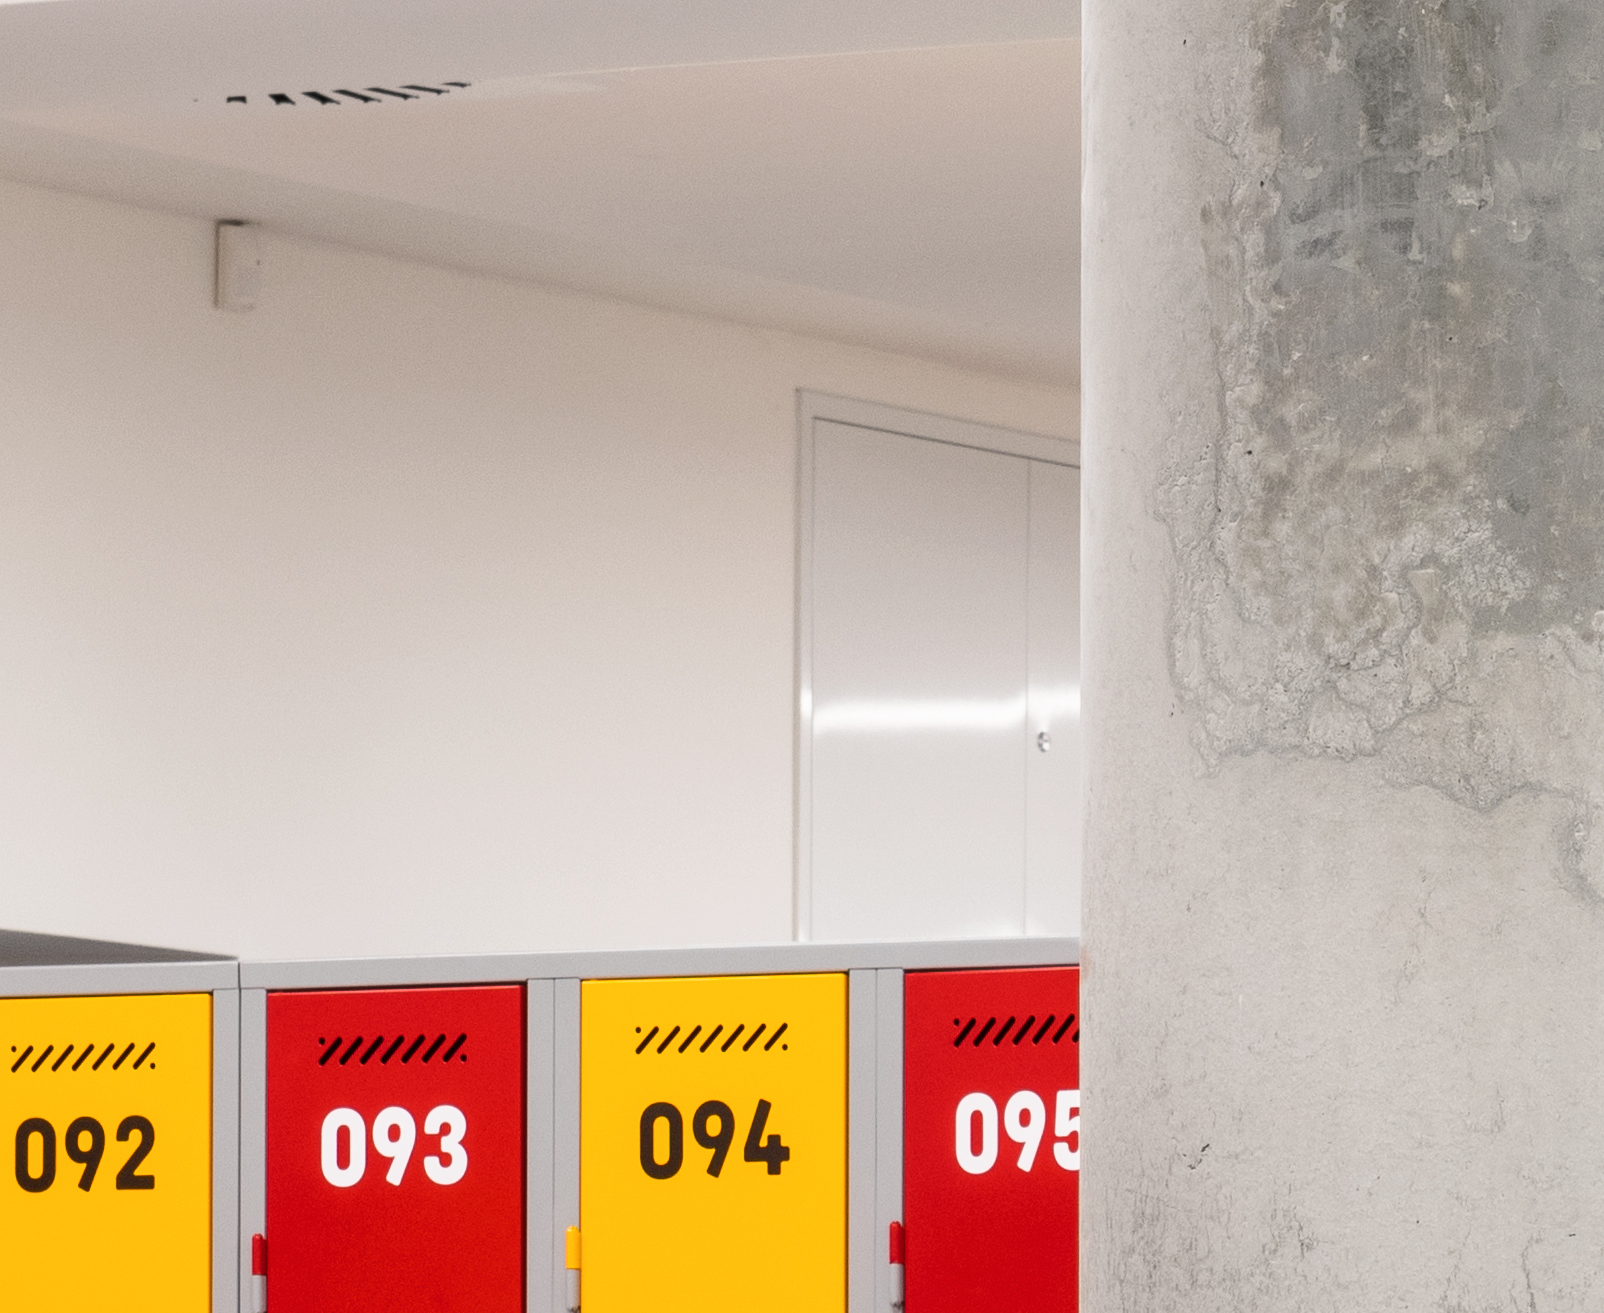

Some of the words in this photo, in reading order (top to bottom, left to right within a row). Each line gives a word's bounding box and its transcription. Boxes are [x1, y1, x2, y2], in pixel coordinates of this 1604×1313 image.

[14, 1115, 155, 1193] 092
[320, 1104, 468, 1188] 093
[639, 1098, 790, 1180] 094
